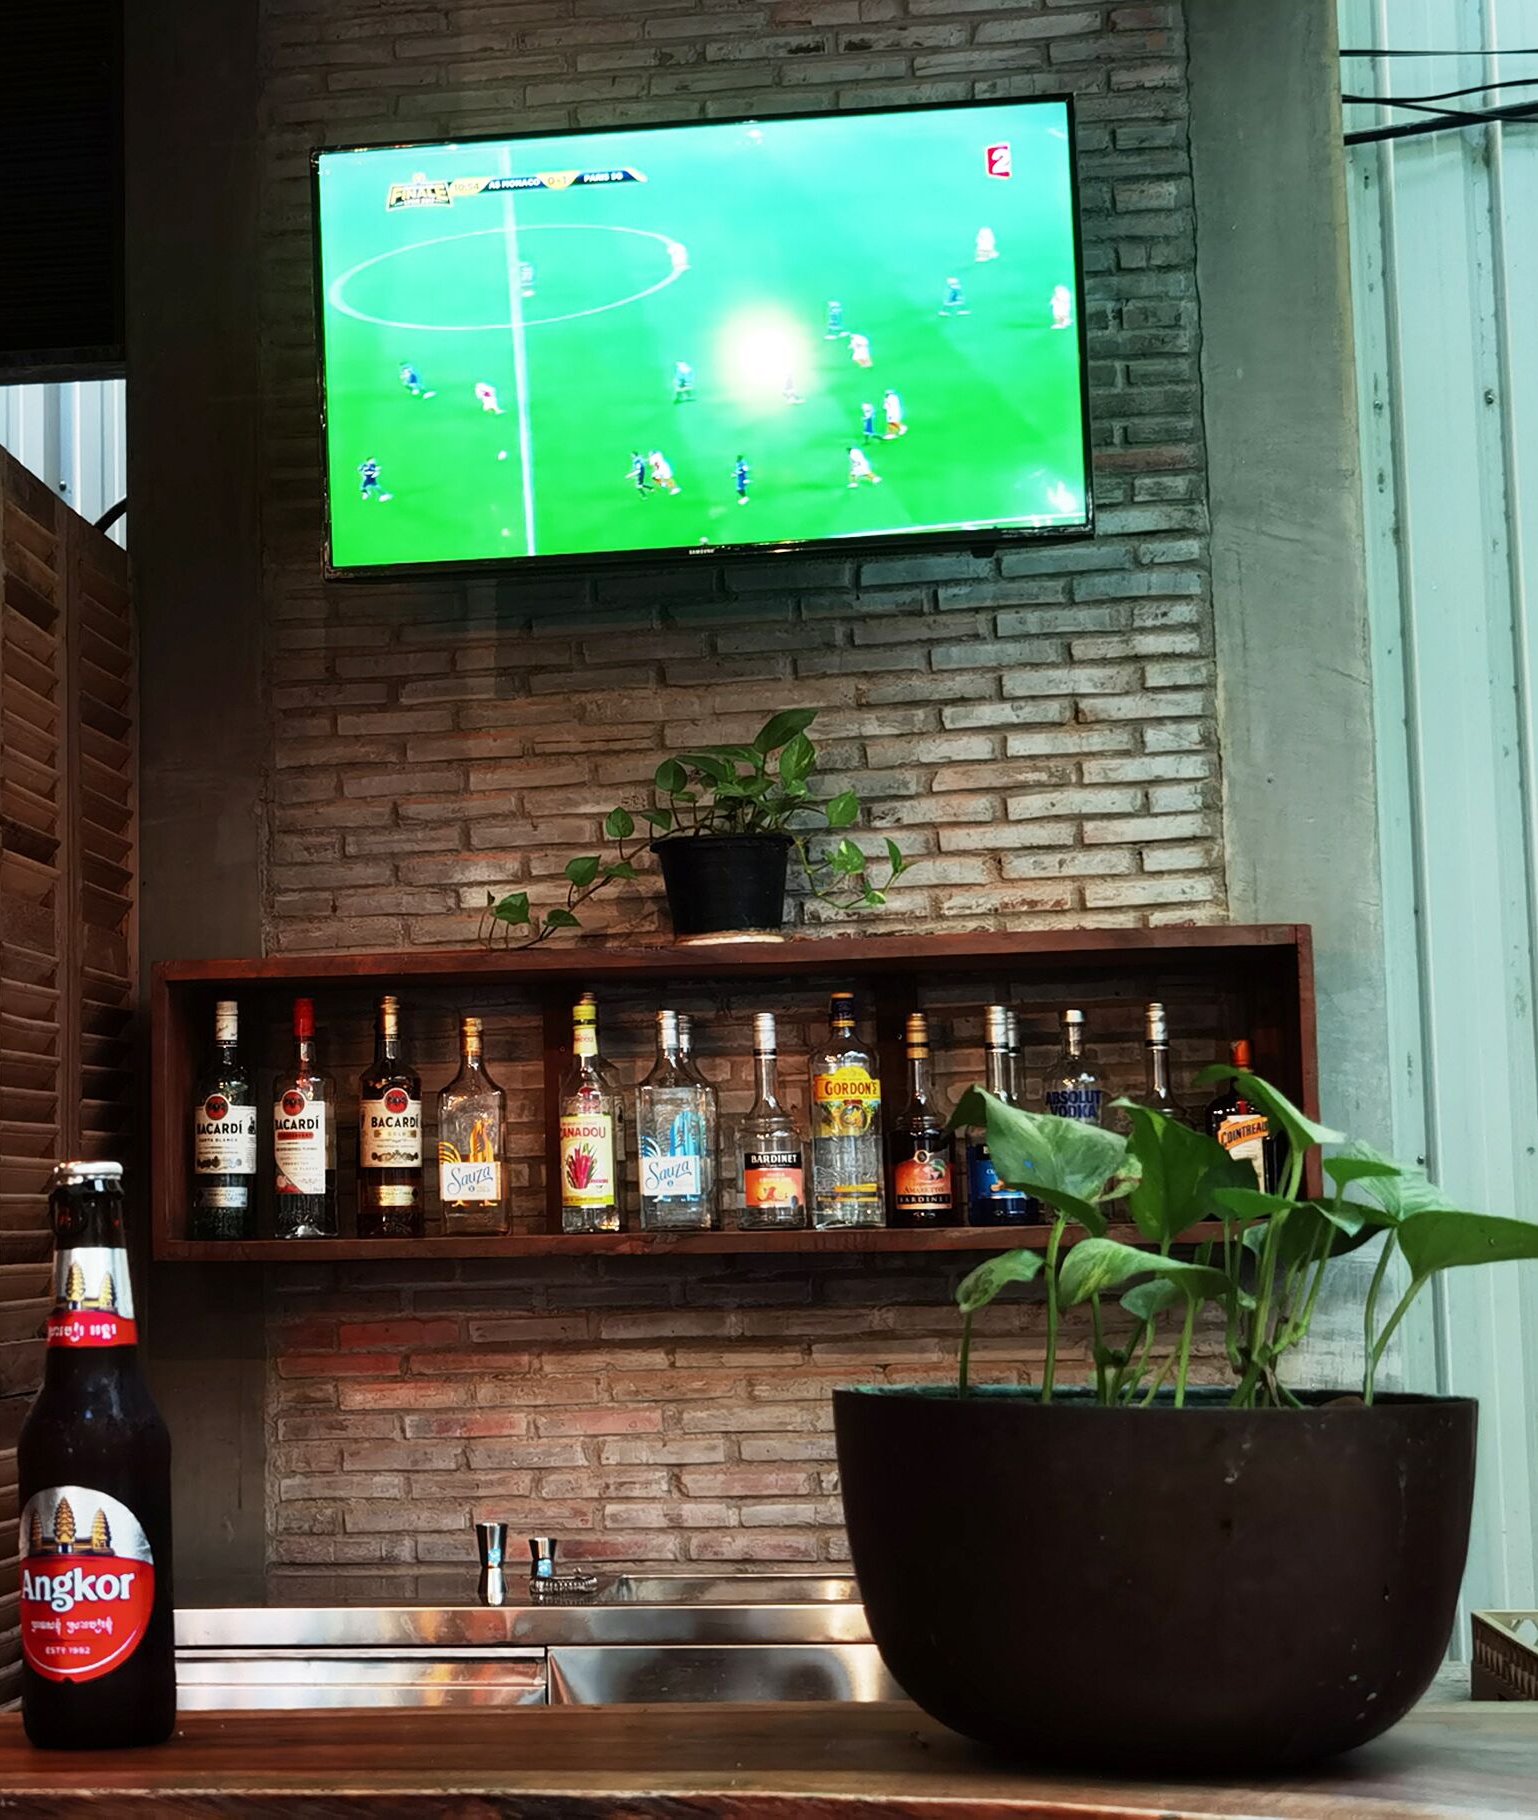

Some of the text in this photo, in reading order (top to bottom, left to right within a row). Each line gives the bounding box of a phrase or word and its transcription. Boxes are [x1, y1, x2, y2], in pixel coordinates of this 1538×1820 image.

[501, 178, 540, 189] MONACO
[583, 173, 609, 183] PARIS
[1046, 1090, 1101, 1105] ABSOLUT
[1050, 1104, 1096, 1117] VODKA
[371, 1114, 419, 1129] BACARDÍ
[751, 1154, 797, 1163] BARDINET
[446, 1165, 494, 1195] Sauza
[645, 1160, 692, 1190] Sauza
[22, 1567, 135, 1612] Angkor
